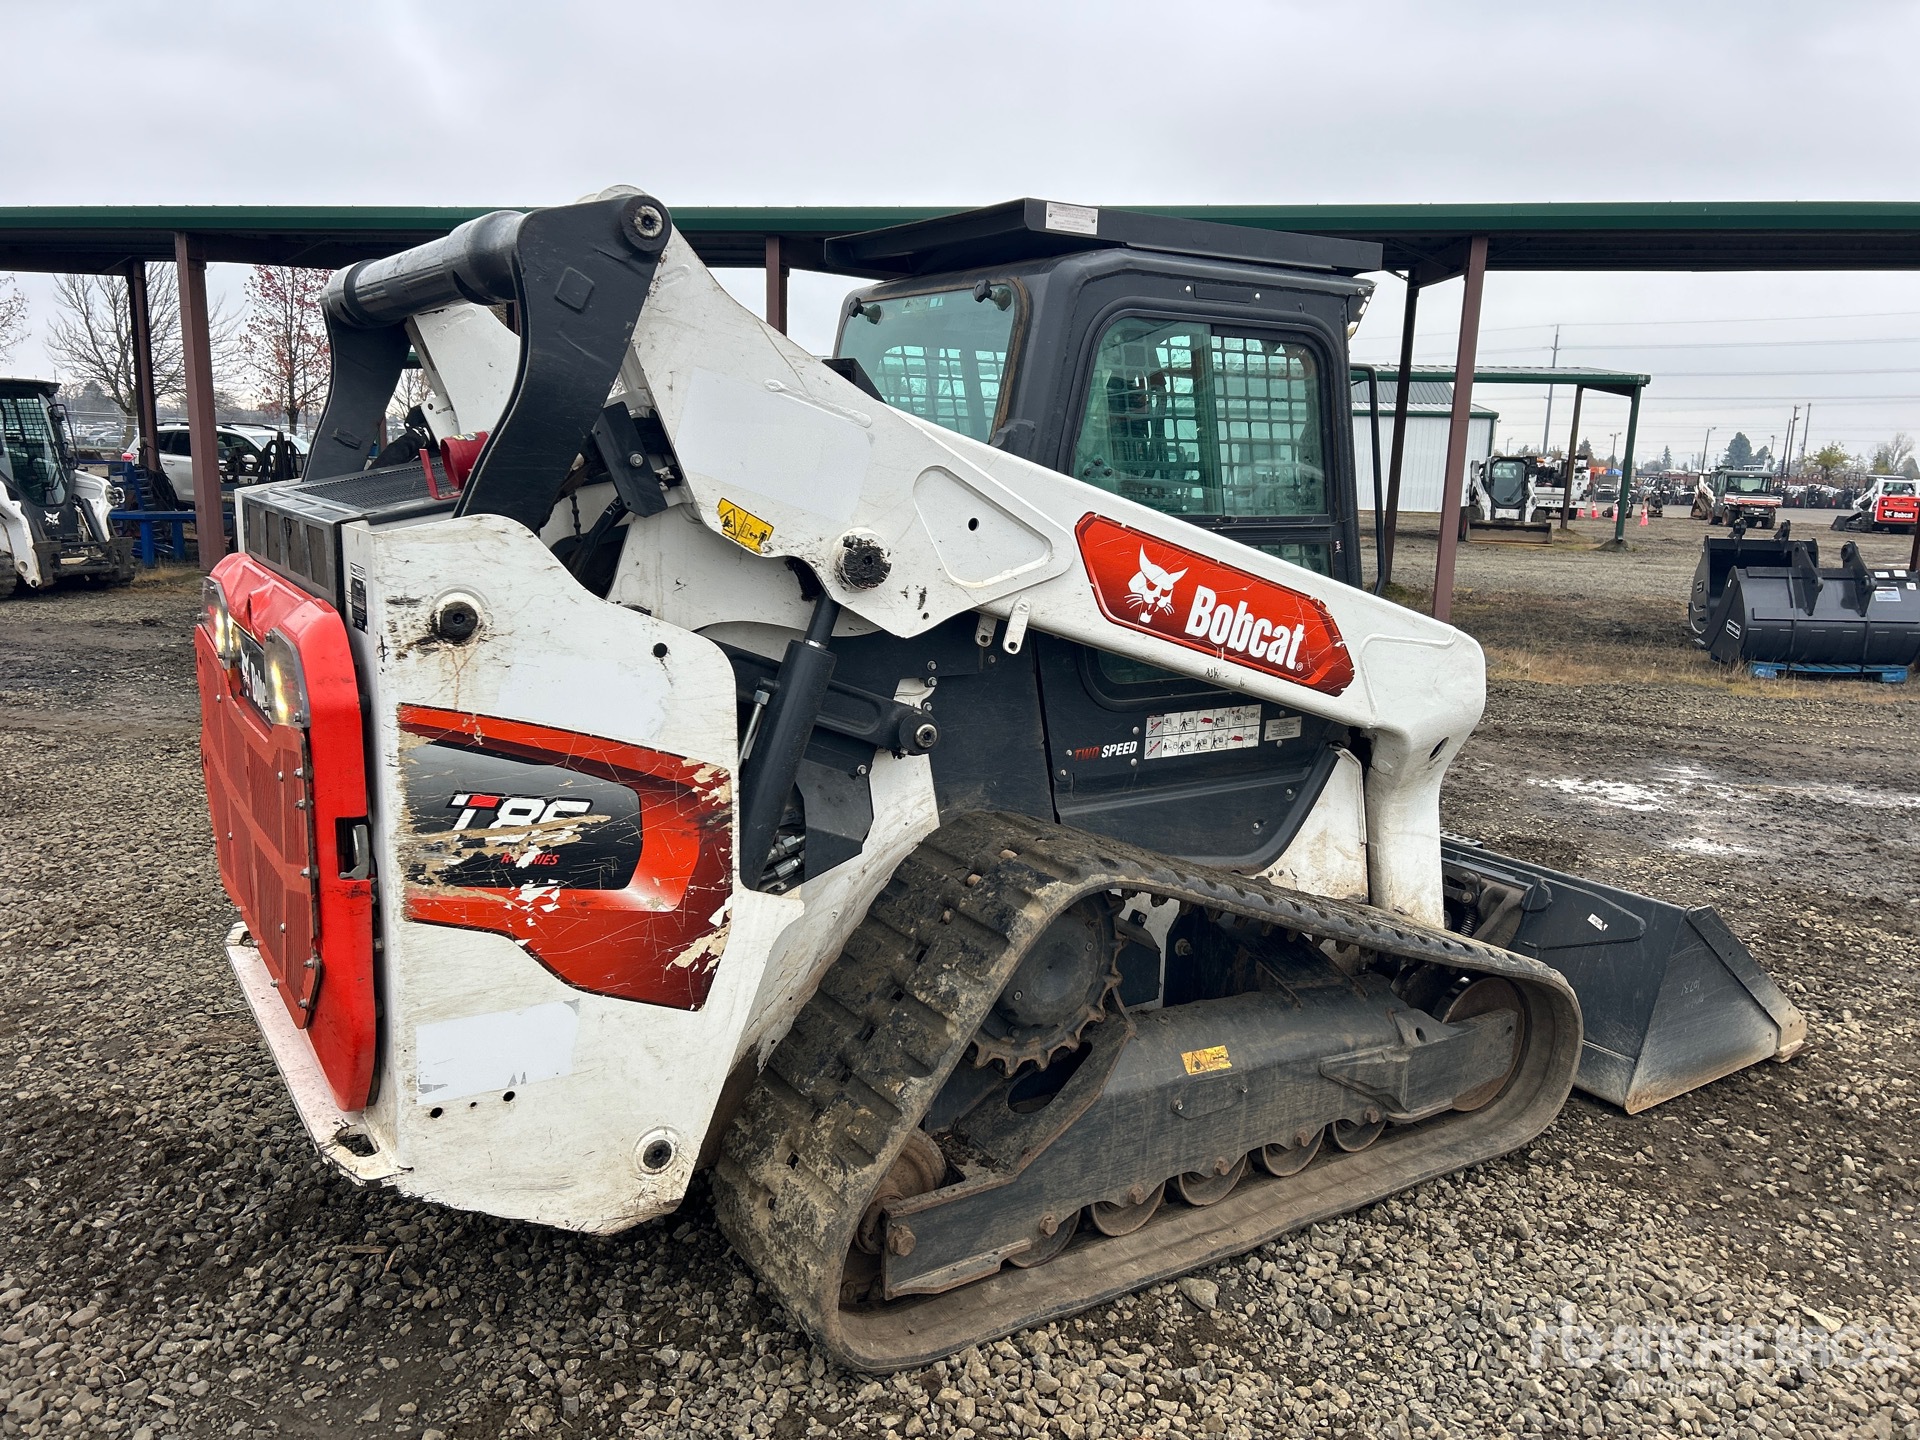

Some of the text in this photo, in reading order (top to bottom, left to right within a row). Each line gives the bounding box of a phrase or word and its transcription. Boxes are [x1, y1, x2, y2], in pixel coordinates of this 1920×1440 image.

[1184, 584, 1304, 670] Bobcat
[1074, 741, 1138, 762] TWO SPEED
[501, 851, 560, 866] R-RIES
